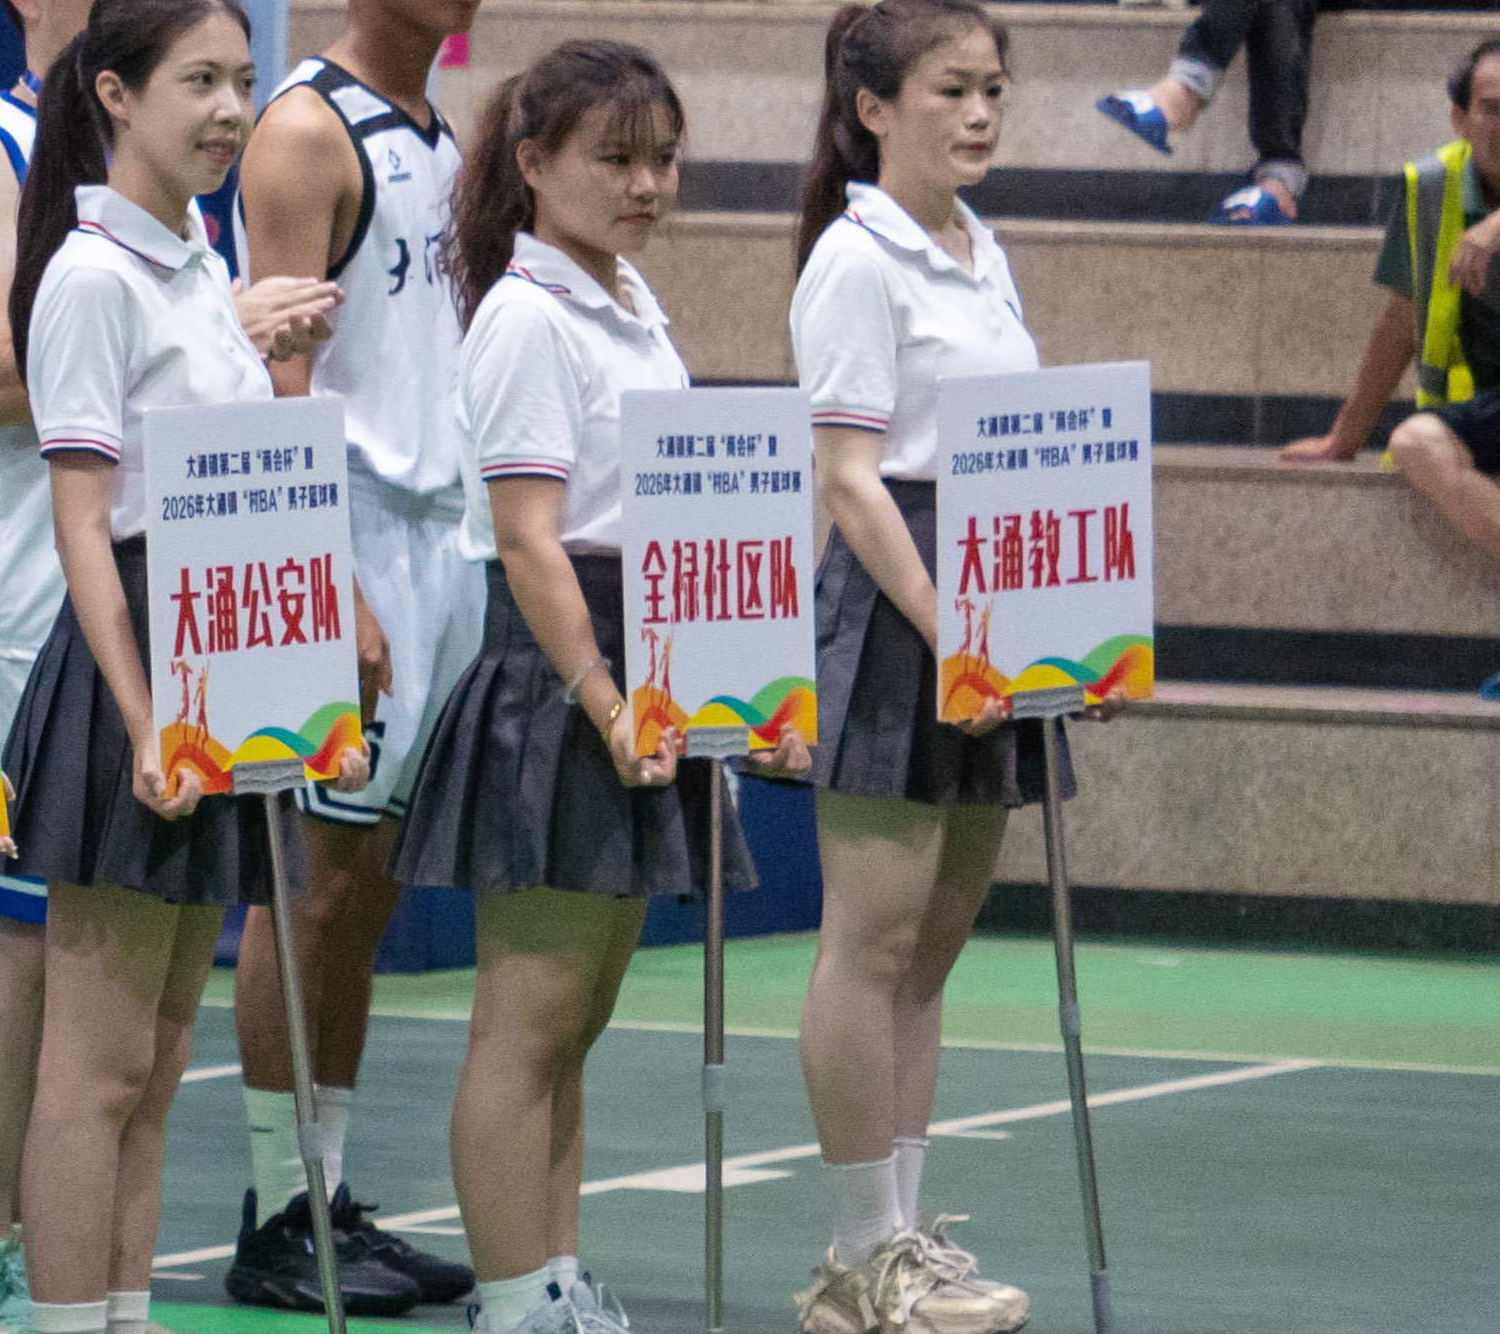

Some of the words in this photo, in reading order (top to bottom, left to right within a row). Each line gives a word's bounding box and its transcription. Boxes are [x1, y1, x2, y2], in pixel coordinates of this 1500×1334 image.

[641, 536, 800, 624] 全禄社区队
[956, 502, 1136, 595] 大涌教工队
[170, 553, 342, 658] 大涌公安队
